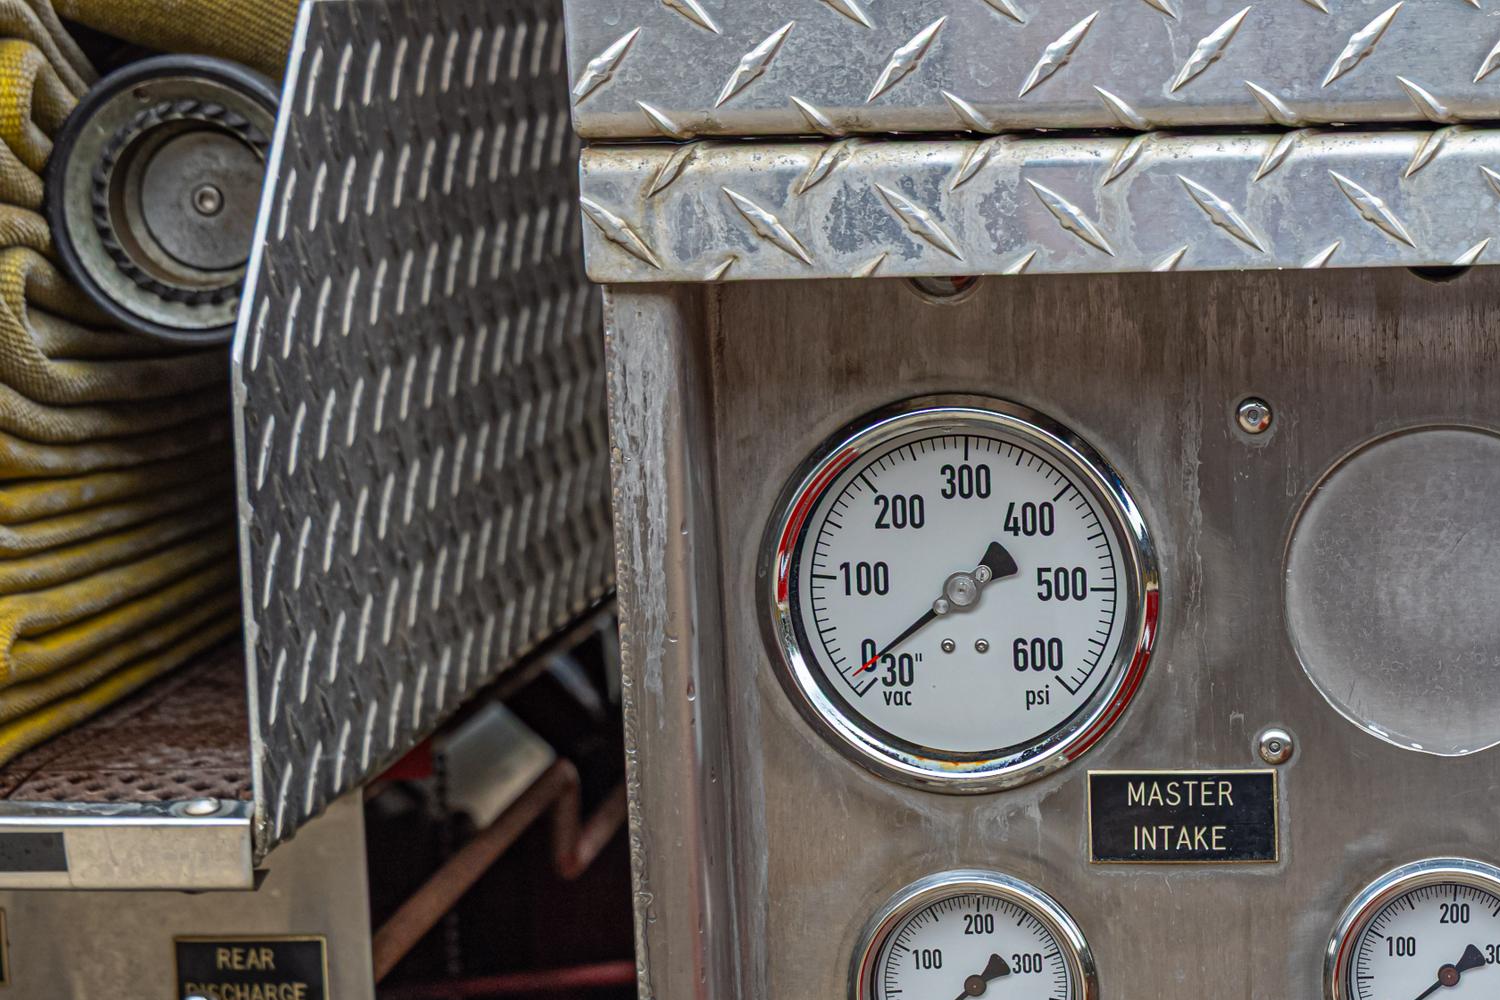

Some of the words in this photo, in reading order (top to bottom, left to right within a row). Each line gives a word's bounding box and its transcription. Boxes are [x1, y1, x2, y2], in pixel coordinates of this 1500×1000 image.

[941, 464, 991, 499] 300
[874, 494, 924, 529] 200
[1004, 502, 1054, 536] 400
[840, 562, 889, 596] 100
[1037, 567, 1087, 601] 500
[861, 638, 876, 672] 0
[1013, 638, 1063, 671] 600
[883, 690, 912, 706] vac
[1026, 686, 1050, 710] psi
[1128, 781, 1233, 806] MASTER
[1134, 826, 1226, 850] INTAKE
[964, 914, 994, 934] 200
[1440, 904, 1470, 924] 200
[216, 948, 275, 970] REAR
[913, 949, 942, 969] 100
[1386, 937, 1416, 957] 100
[1012, 953, 1042, 973] 300
